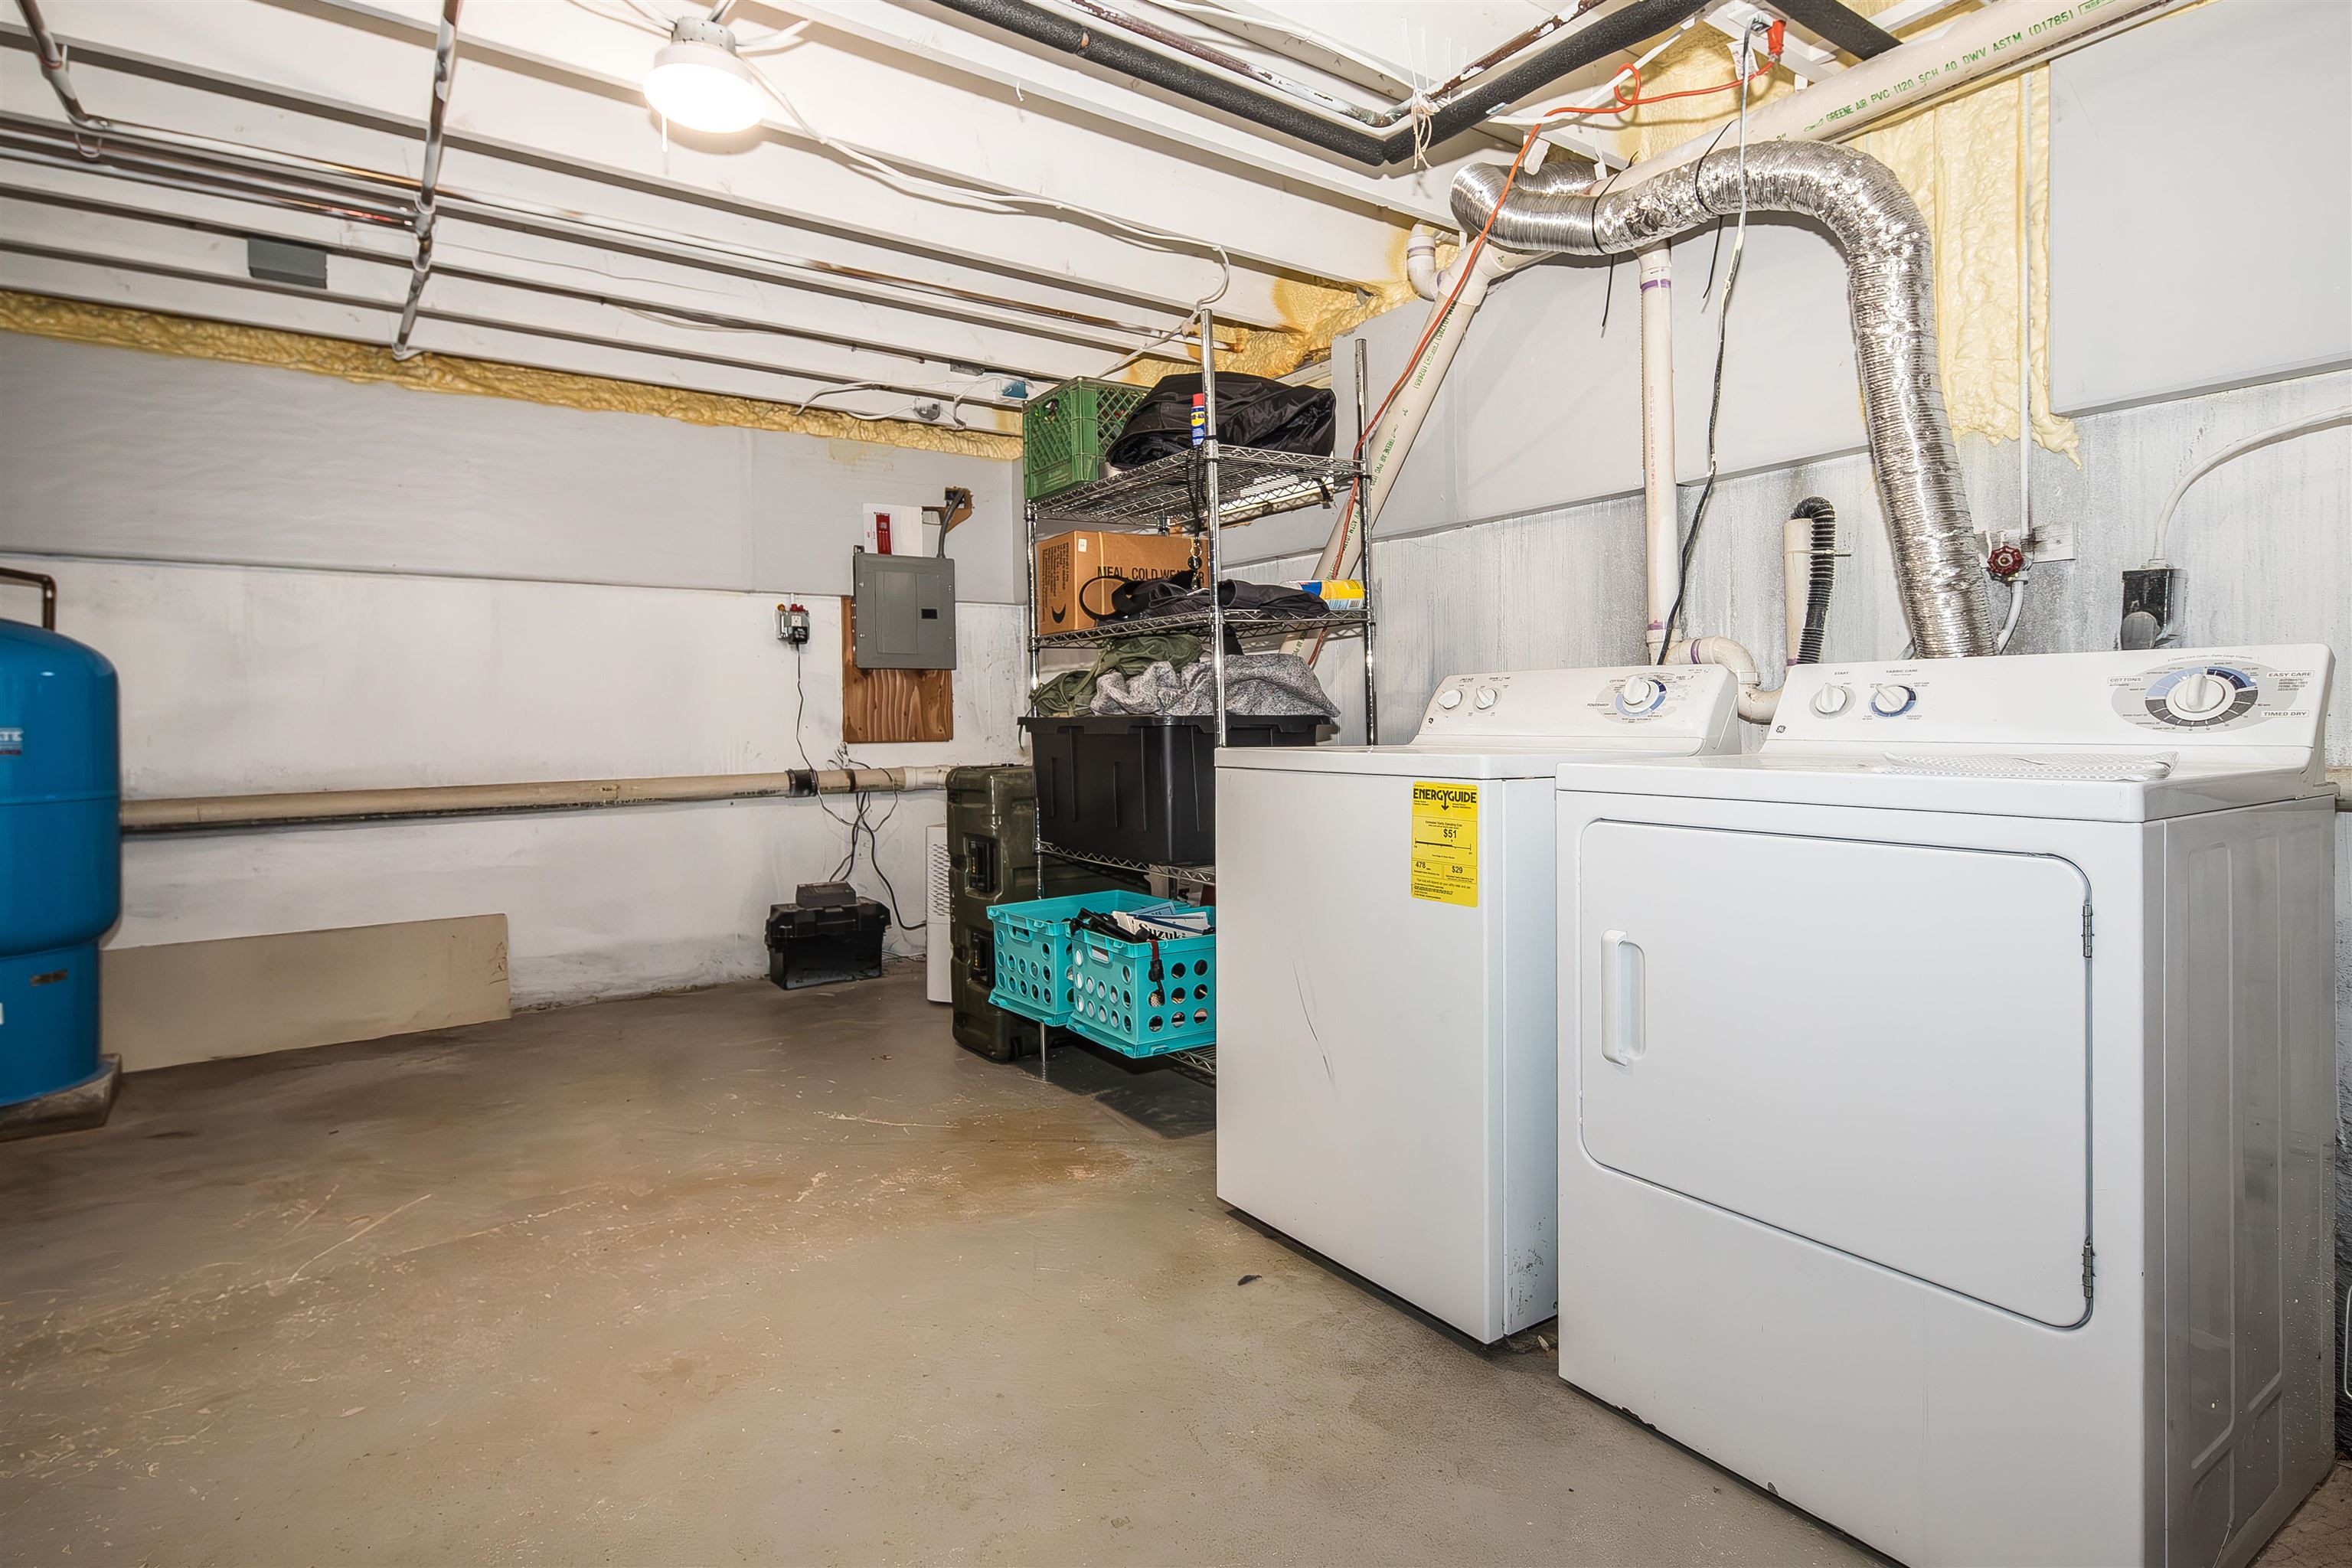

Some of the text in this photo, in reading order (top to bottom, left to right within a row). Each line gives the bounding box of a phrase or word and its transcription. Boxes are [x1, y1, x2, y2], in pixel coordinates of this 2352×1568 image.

[1826, 105, 1854, 122] GREENE
[1855, 99, 1869, 114] AIR
[1870, 89, 1890, 104] PVC
[1893, 79, 1914, 94] 1120
[1918, 68, 1939, 83] SCH
[1945, 60, 1958, 73] 40
[1962, 47, 1987, 65] DWV
[1993, 31, 2023, 53] ASTM
[2028, 9, 2074, 37] (D1785)
[1131, 567, 1158, 581] COLD
[1413, 788, 1477, 804] ENERGYGUIDE
[1443, 828, 1457, 839] $51
[1452, 865, 1463, 874] $29
